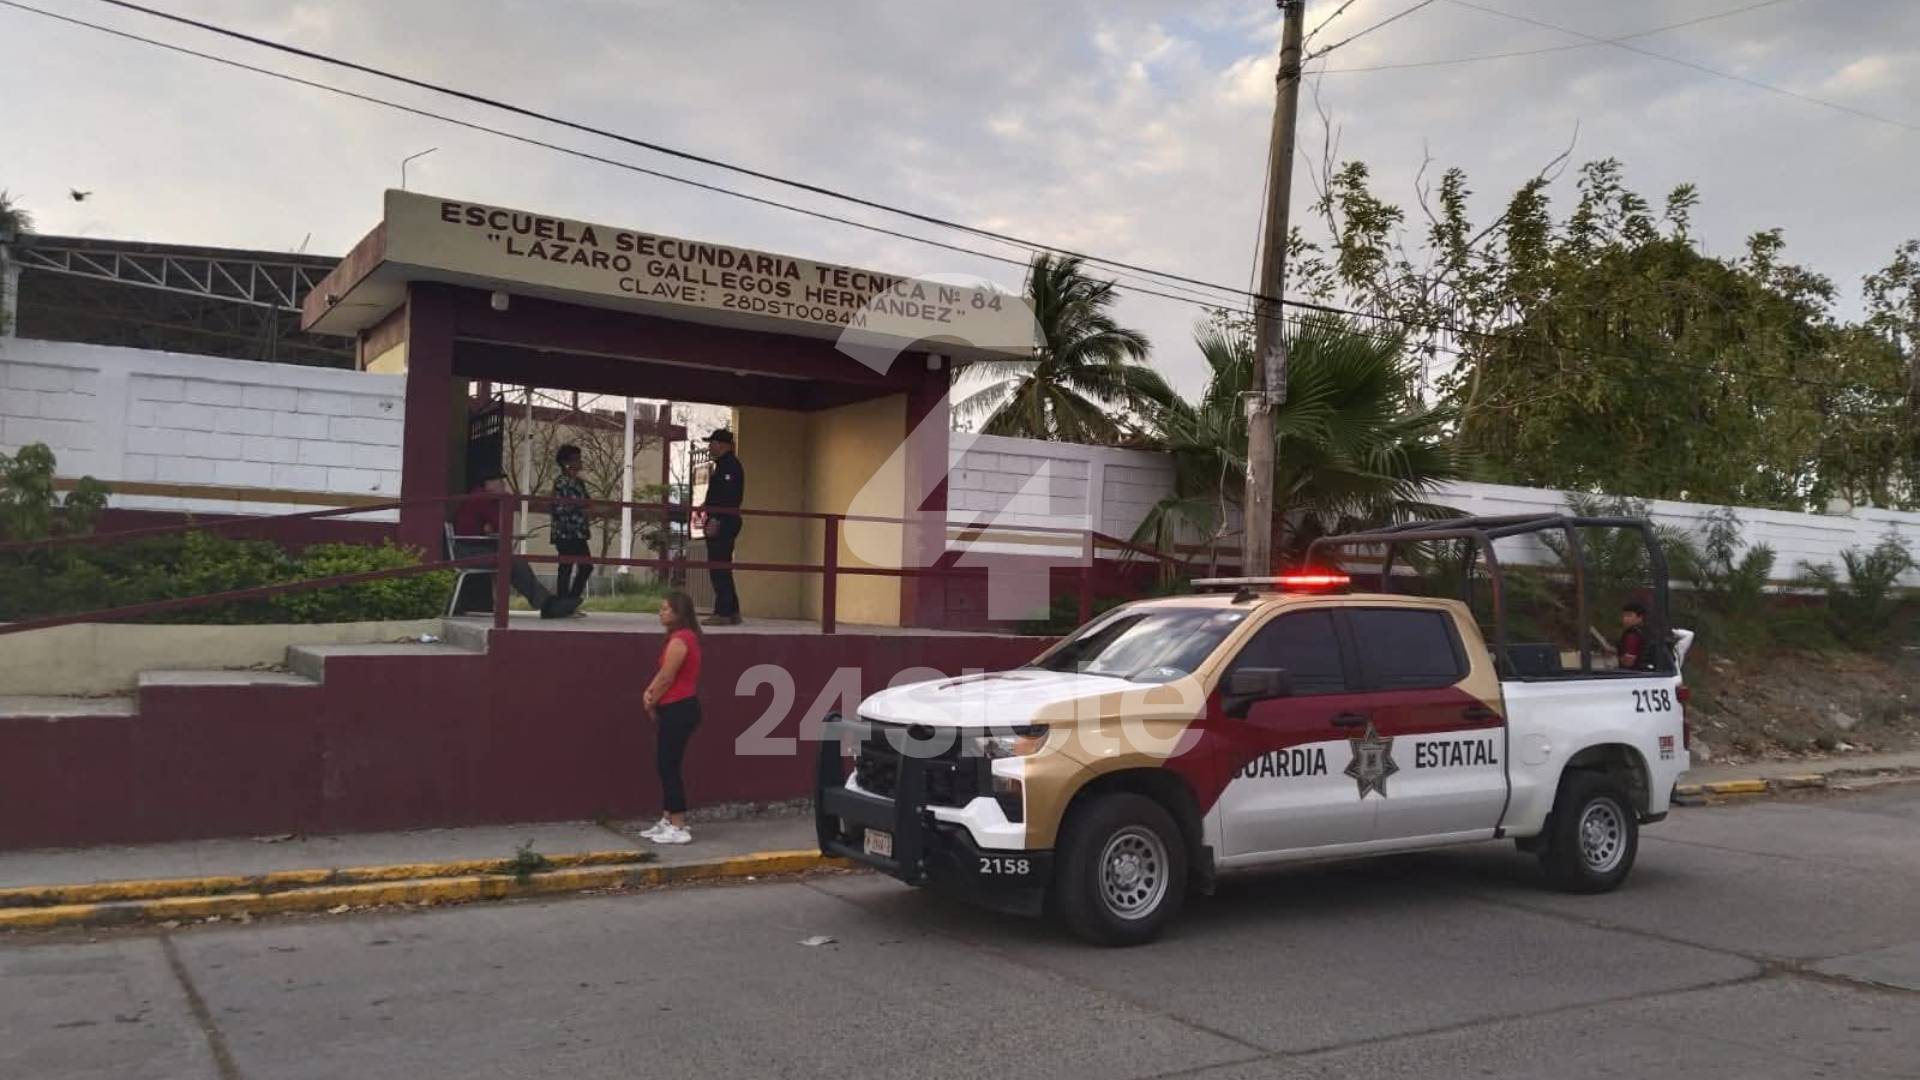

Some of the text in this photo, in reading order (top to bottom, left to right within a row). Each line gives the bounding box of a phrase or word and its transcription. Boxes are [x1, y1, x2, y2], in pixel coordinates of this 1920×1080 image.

[440, 202, 599, 247] ESCUELA
[615, 232, 801, 280] SECUNDARIA
[970, 292, 1003, 312] 84
[618, 276, 706, 302] CLAVE:
[646, 259, 792, 298] GALLEGOS
[1631, 688, 1672, 713] 2158
[1415, 739, 1498, 769] ESTATAL
[979, 857, 1030, 875] 2158
